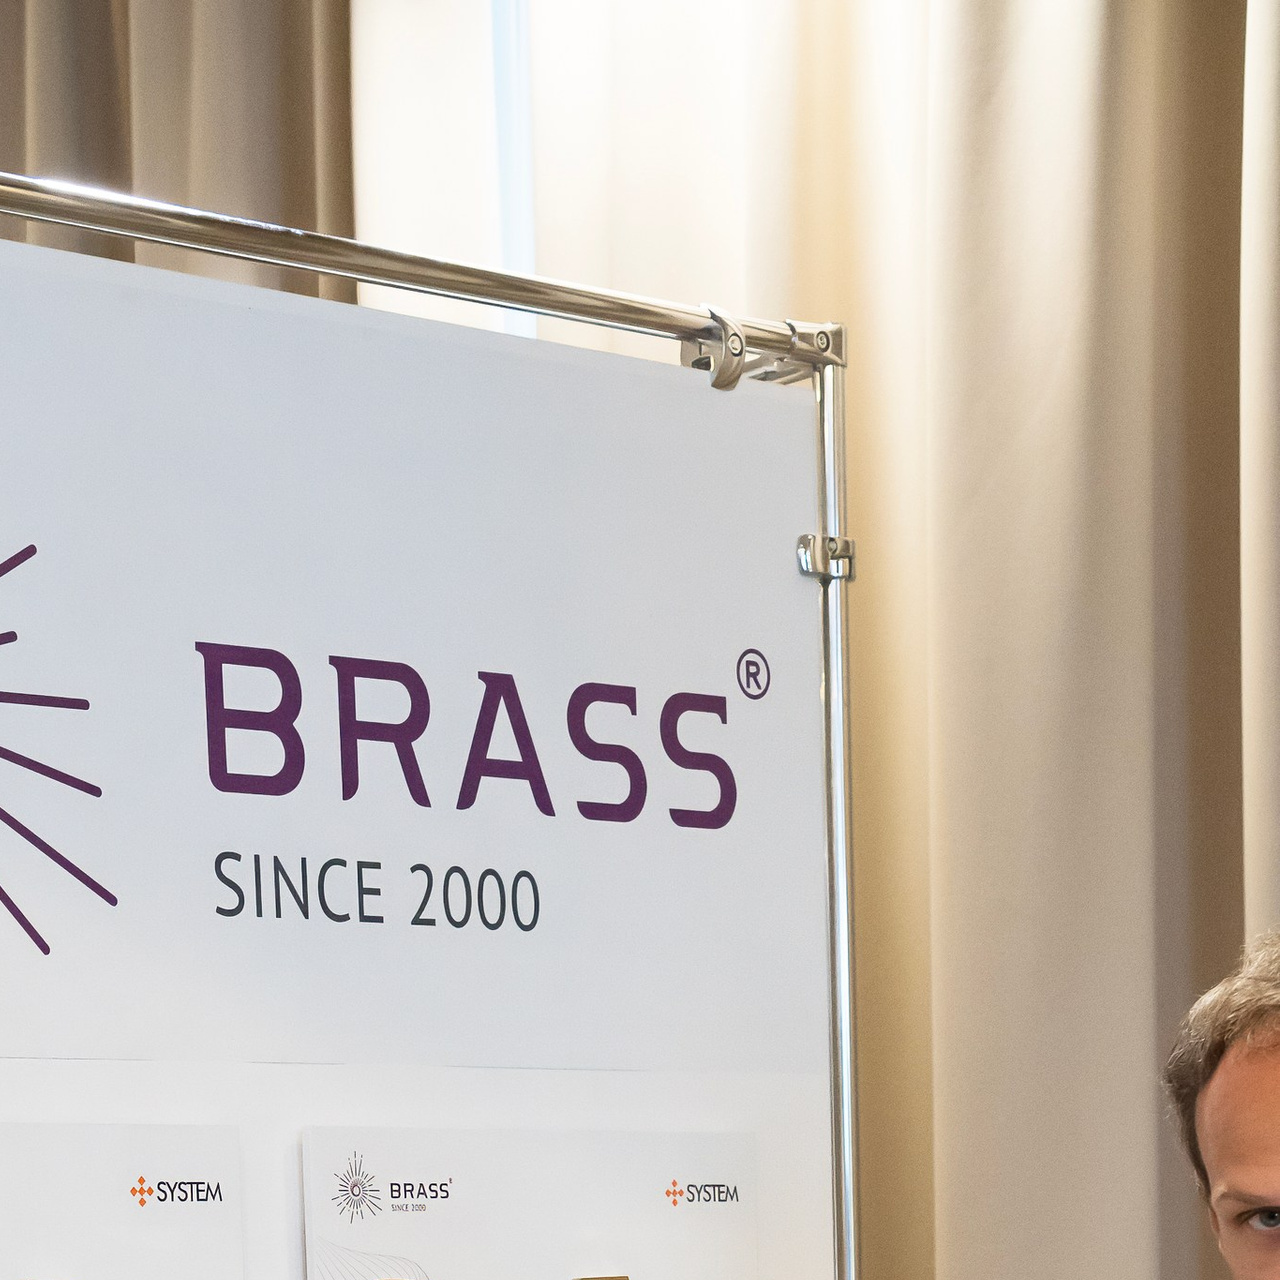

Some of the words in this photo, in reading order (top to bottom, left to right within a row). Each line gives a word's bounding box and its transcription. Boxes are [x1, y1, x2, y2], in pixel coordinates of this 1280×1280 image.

[213, 851, 385, 924] SINCE
[410, 862, 541, 932] 2000
[156, 1181, 223, 1202] SYSTEM
[686, 1184, 739, 1203] SYSTEM
[391, 1203, 409, 1212] SINCE
[411, 1203, 427, 1212] 2000
